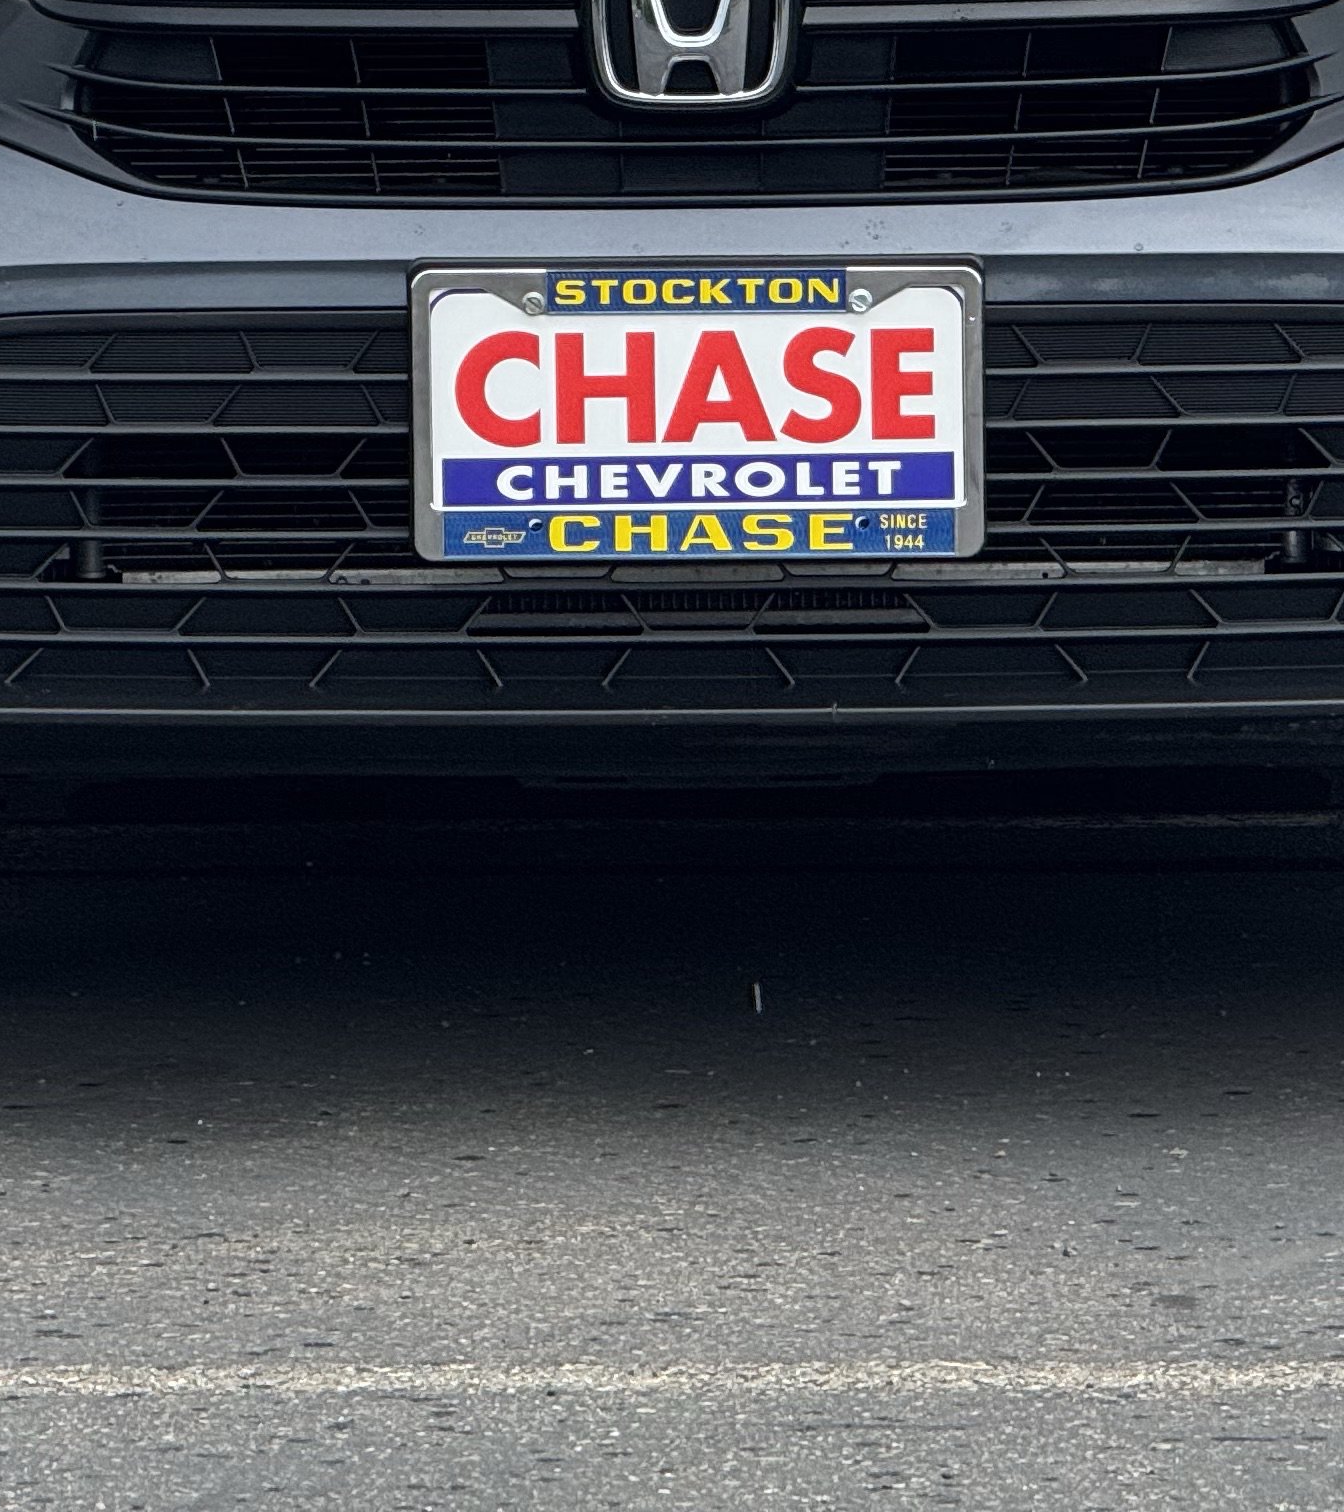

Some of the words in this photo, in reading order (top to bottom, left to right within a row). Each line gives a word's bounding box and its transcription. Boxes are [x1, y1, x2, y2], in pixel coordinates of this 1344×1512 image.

[554, 278, 840, 305] STOCKTON
[454, 326, 936, 448] CHASE
[496, 460, 902, 501] CHEVROLET
[548, 513, 854, 553] CHASE
[879, 513, 928, 529] SINCE
[885, 534, 925, 551] 1944
